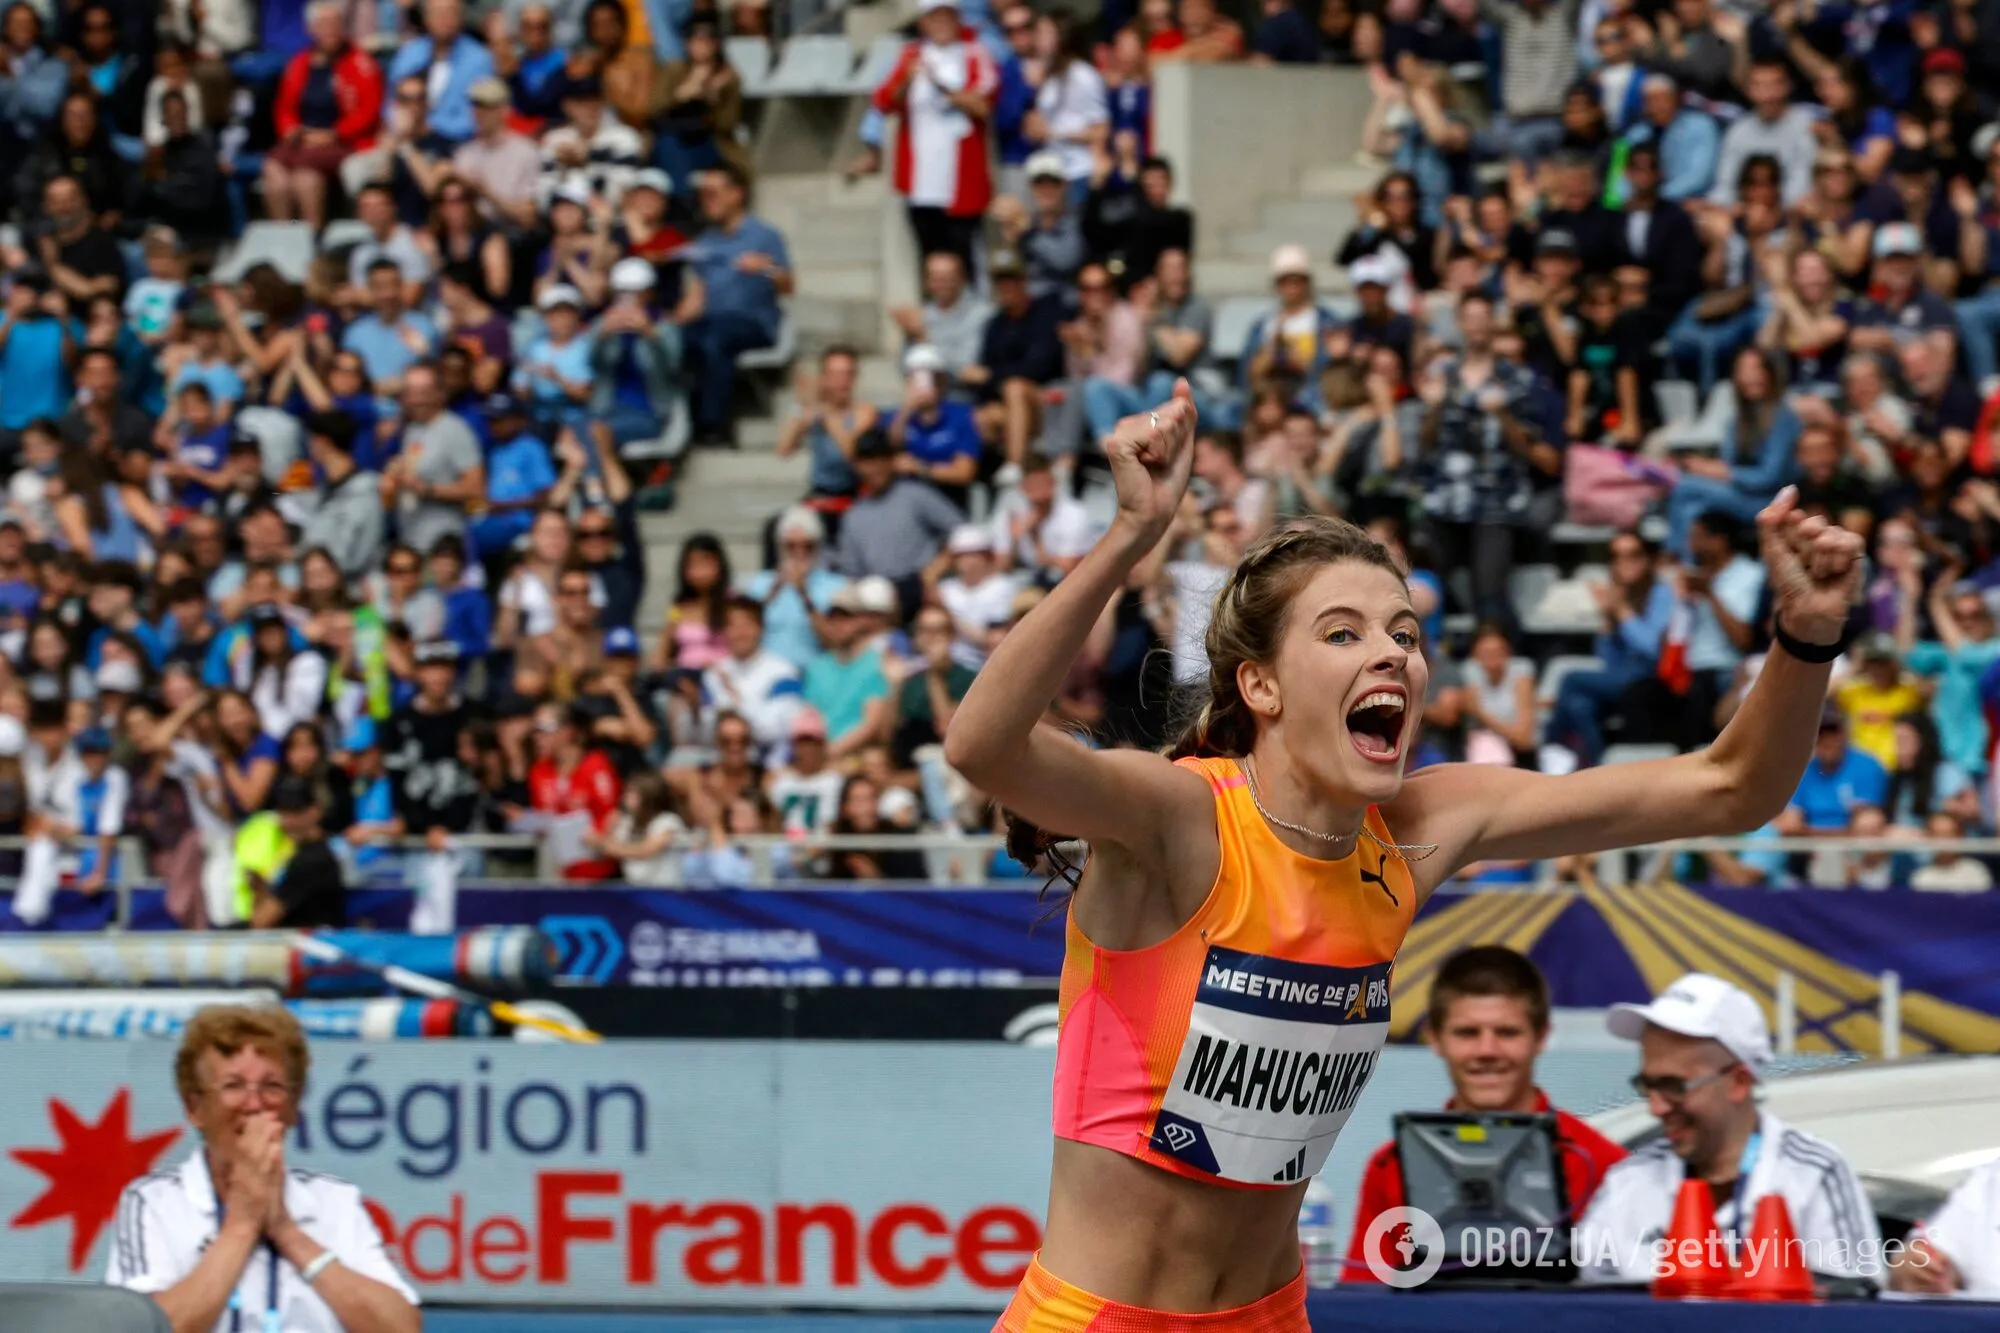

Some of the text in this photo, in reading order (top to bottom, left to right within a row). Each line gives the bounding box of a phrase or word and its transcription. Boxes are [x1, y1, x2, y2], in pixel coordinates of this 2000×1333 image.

[1205, 964, 1388, 1021] MEETING DE PARIS
